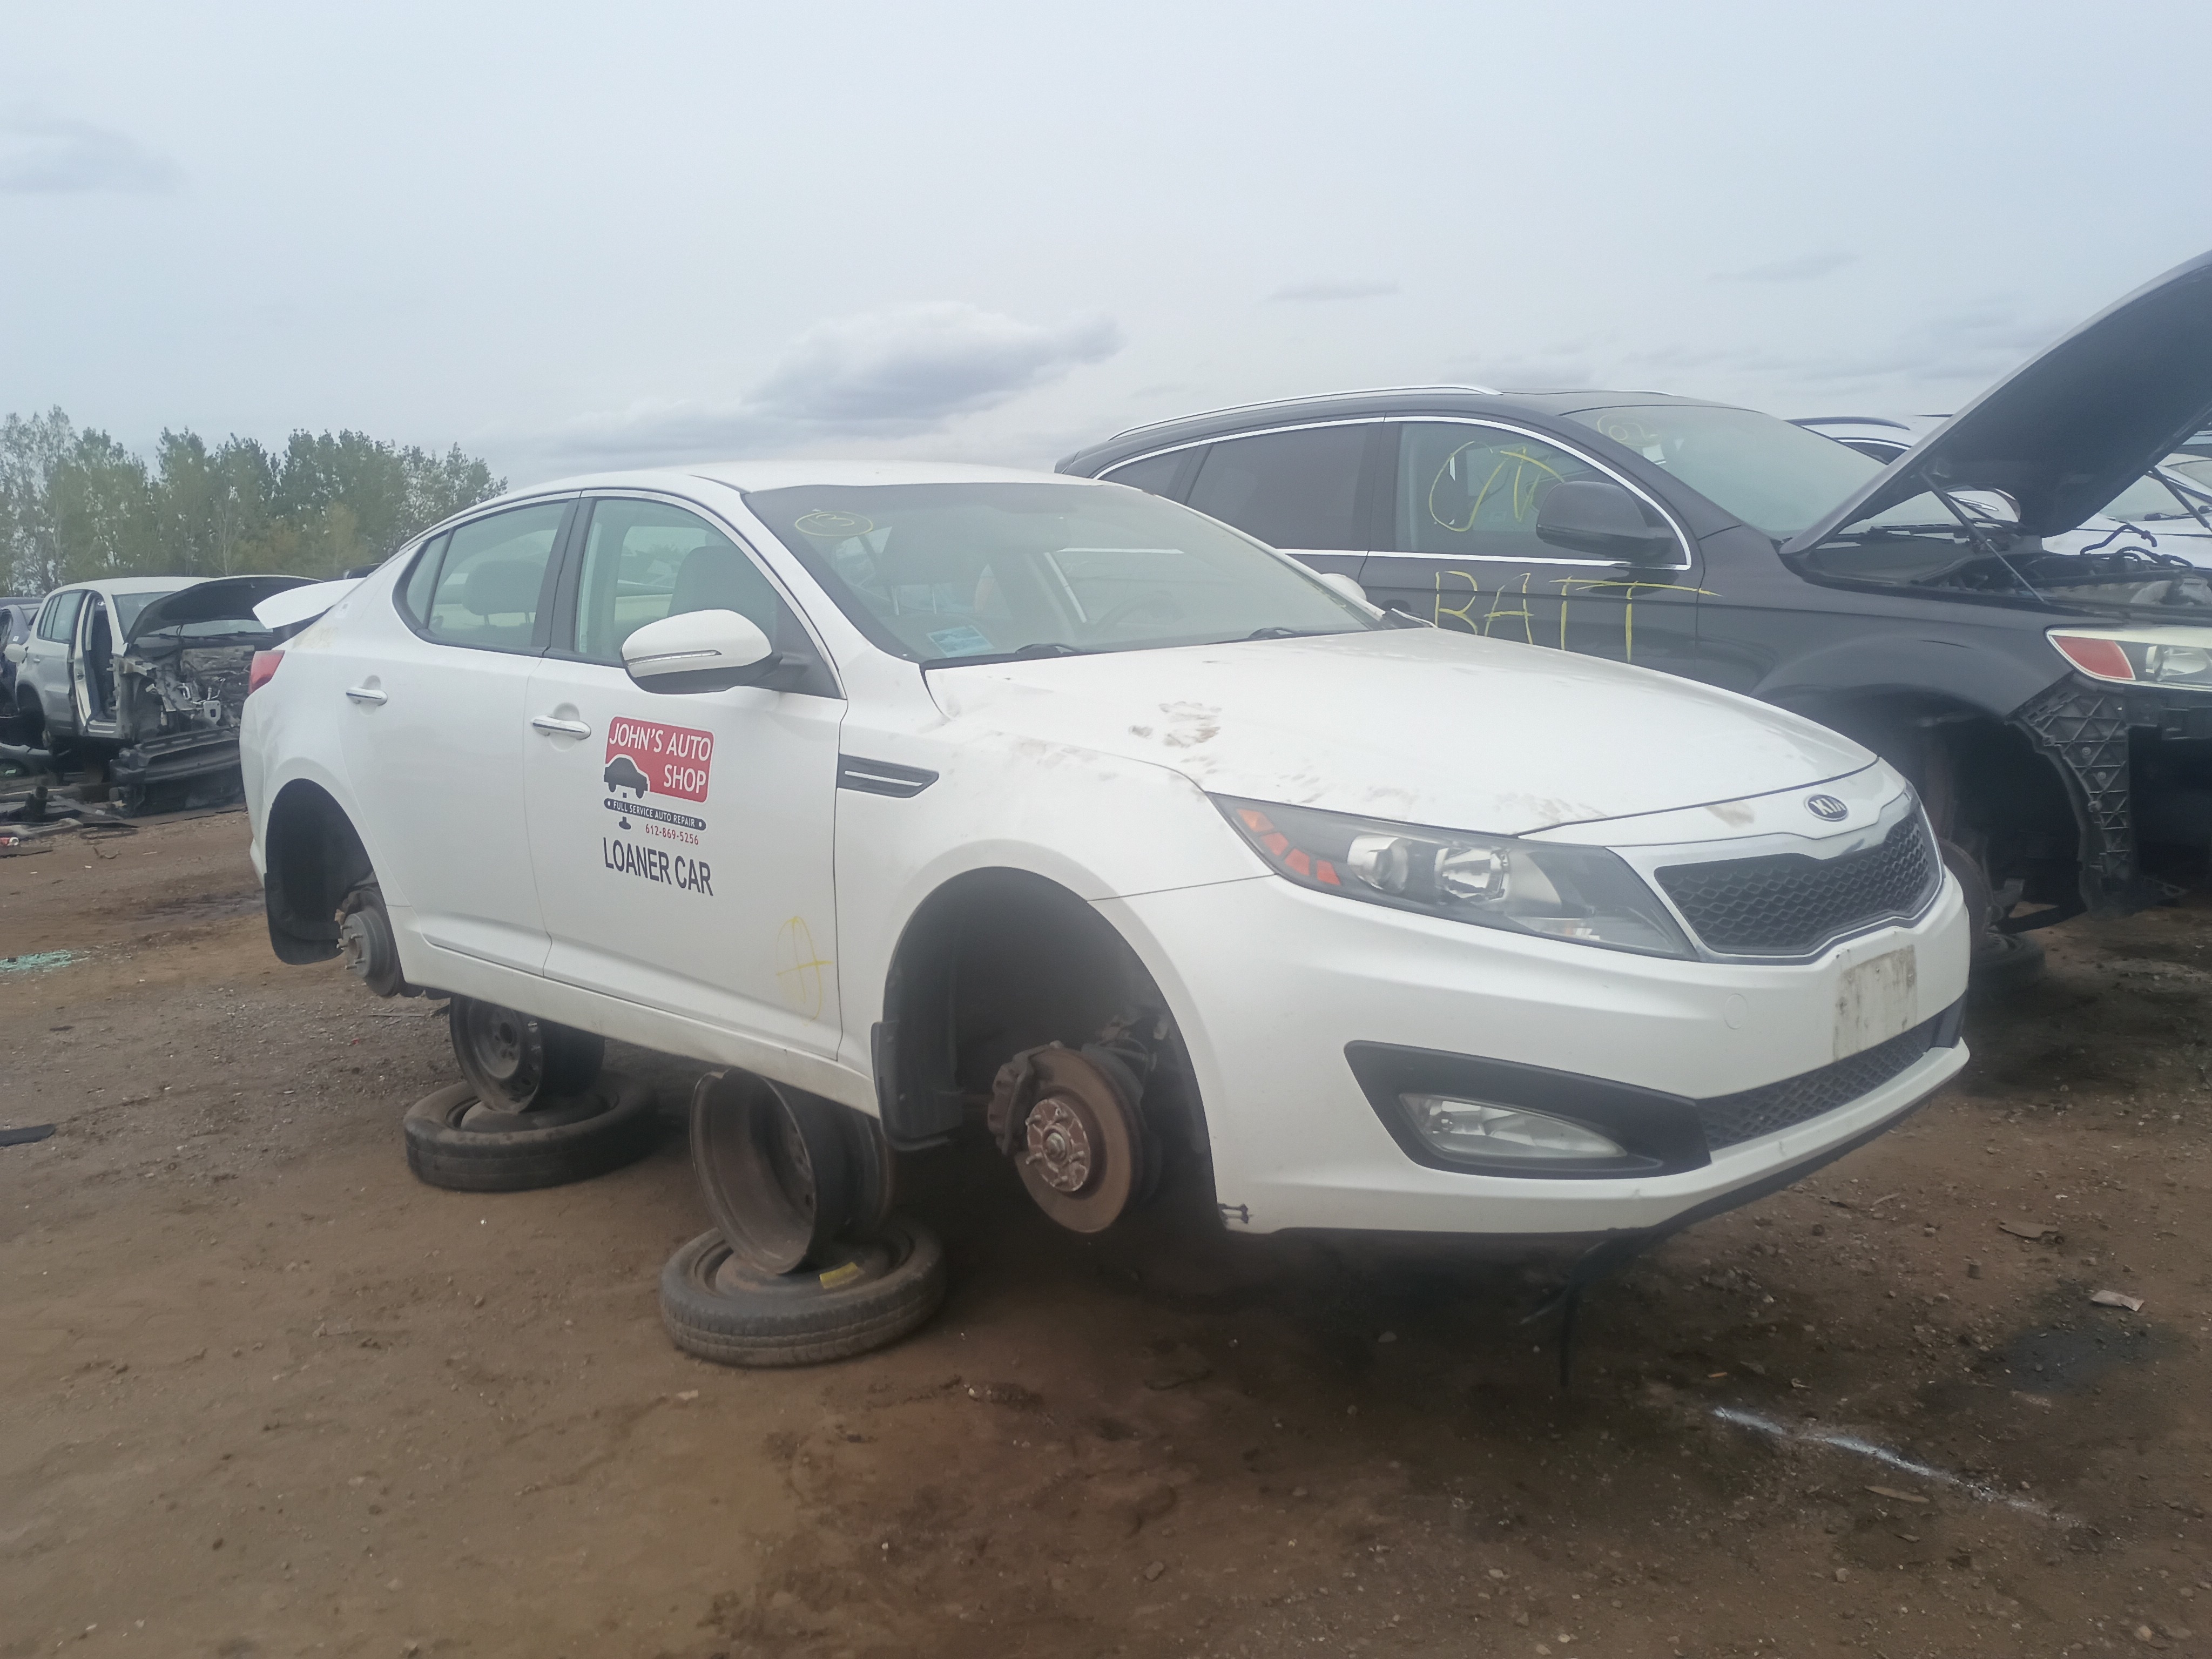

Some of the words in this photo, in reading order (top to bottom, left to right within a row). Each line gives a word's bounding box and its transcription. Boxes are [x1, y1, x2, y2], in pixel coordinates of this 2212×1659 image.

[609, 723, 664, 753] JOHN'S
[665, 732, 711, 761] AUTO
[663, 764, 706, 794] SHOP
[613, 801, 628, 812] FULL
[629, 805, 653, 818] SERVICE
[655, 810, 671, 821] AUTO
[673, 814, 696, 827] REPAIR
[1809, 798, 1846, 815] KIA
[645, 824, 699, 845] 612-869-5256
[603, 837, 672, 885] LOANER
[675, 855, 714, 897] CAR
